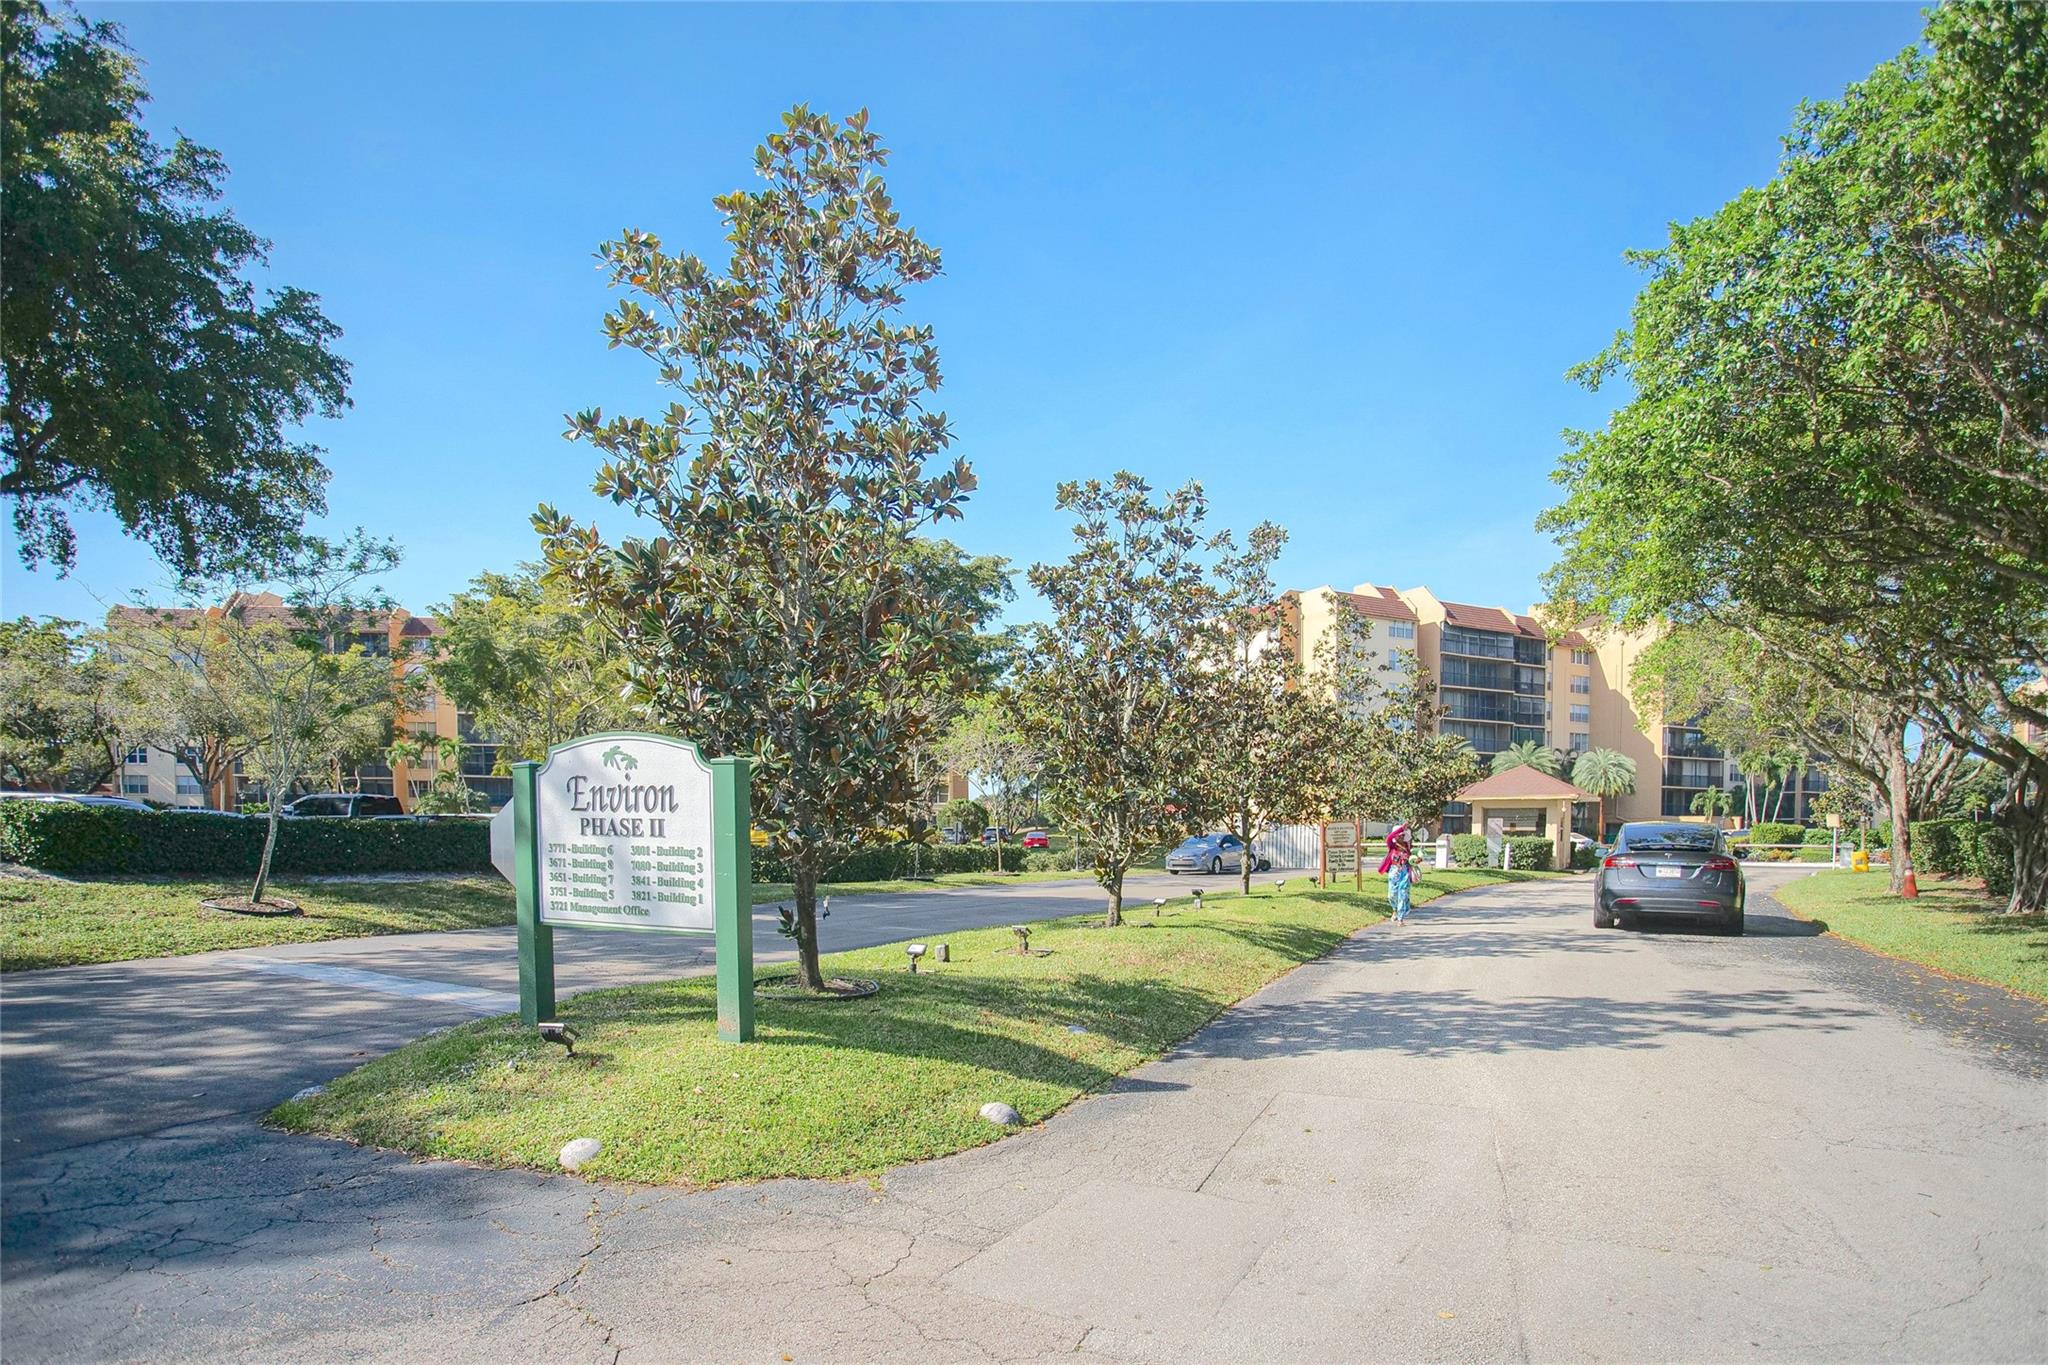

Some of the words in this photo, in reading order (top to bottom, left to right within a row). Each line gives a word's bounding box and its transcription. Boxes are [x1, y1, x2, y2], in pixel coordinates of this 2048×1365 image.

[566, 773, 679, 814] Environ
[580, 817, 644, 838] PHASE
[649, 818, 666, 838] II
[572, 844, 607, 857] Building
[608, 845, 614, 855] 6
[657, 846, 696, 860] Building
[697, 847, 703, 858] 2
[572, 859, 607, 872] Building
[608, 860, 614, 870] 8
[657, 862, 696, 875] Building
[697, 863, 704, 873] 3
[549, 873, 566, 882] 3651
[573, 874, 607, 886] Building
[608, 875, 614, 885] 7
[631, 876, 651, 885] 3841
[657, 877, 696, 890] Building
[697, 879, 704, 888] 4
[573, 888, 608, 901] Building
[608, 890, 614, 900] 5
[632, 891, 651, 901] 3821
[658, 892, 696, 906] Building
[698, 894, 703, 904] 1
[570, 902, 621, 915] Management
[623, 905, 649, 916] Office
